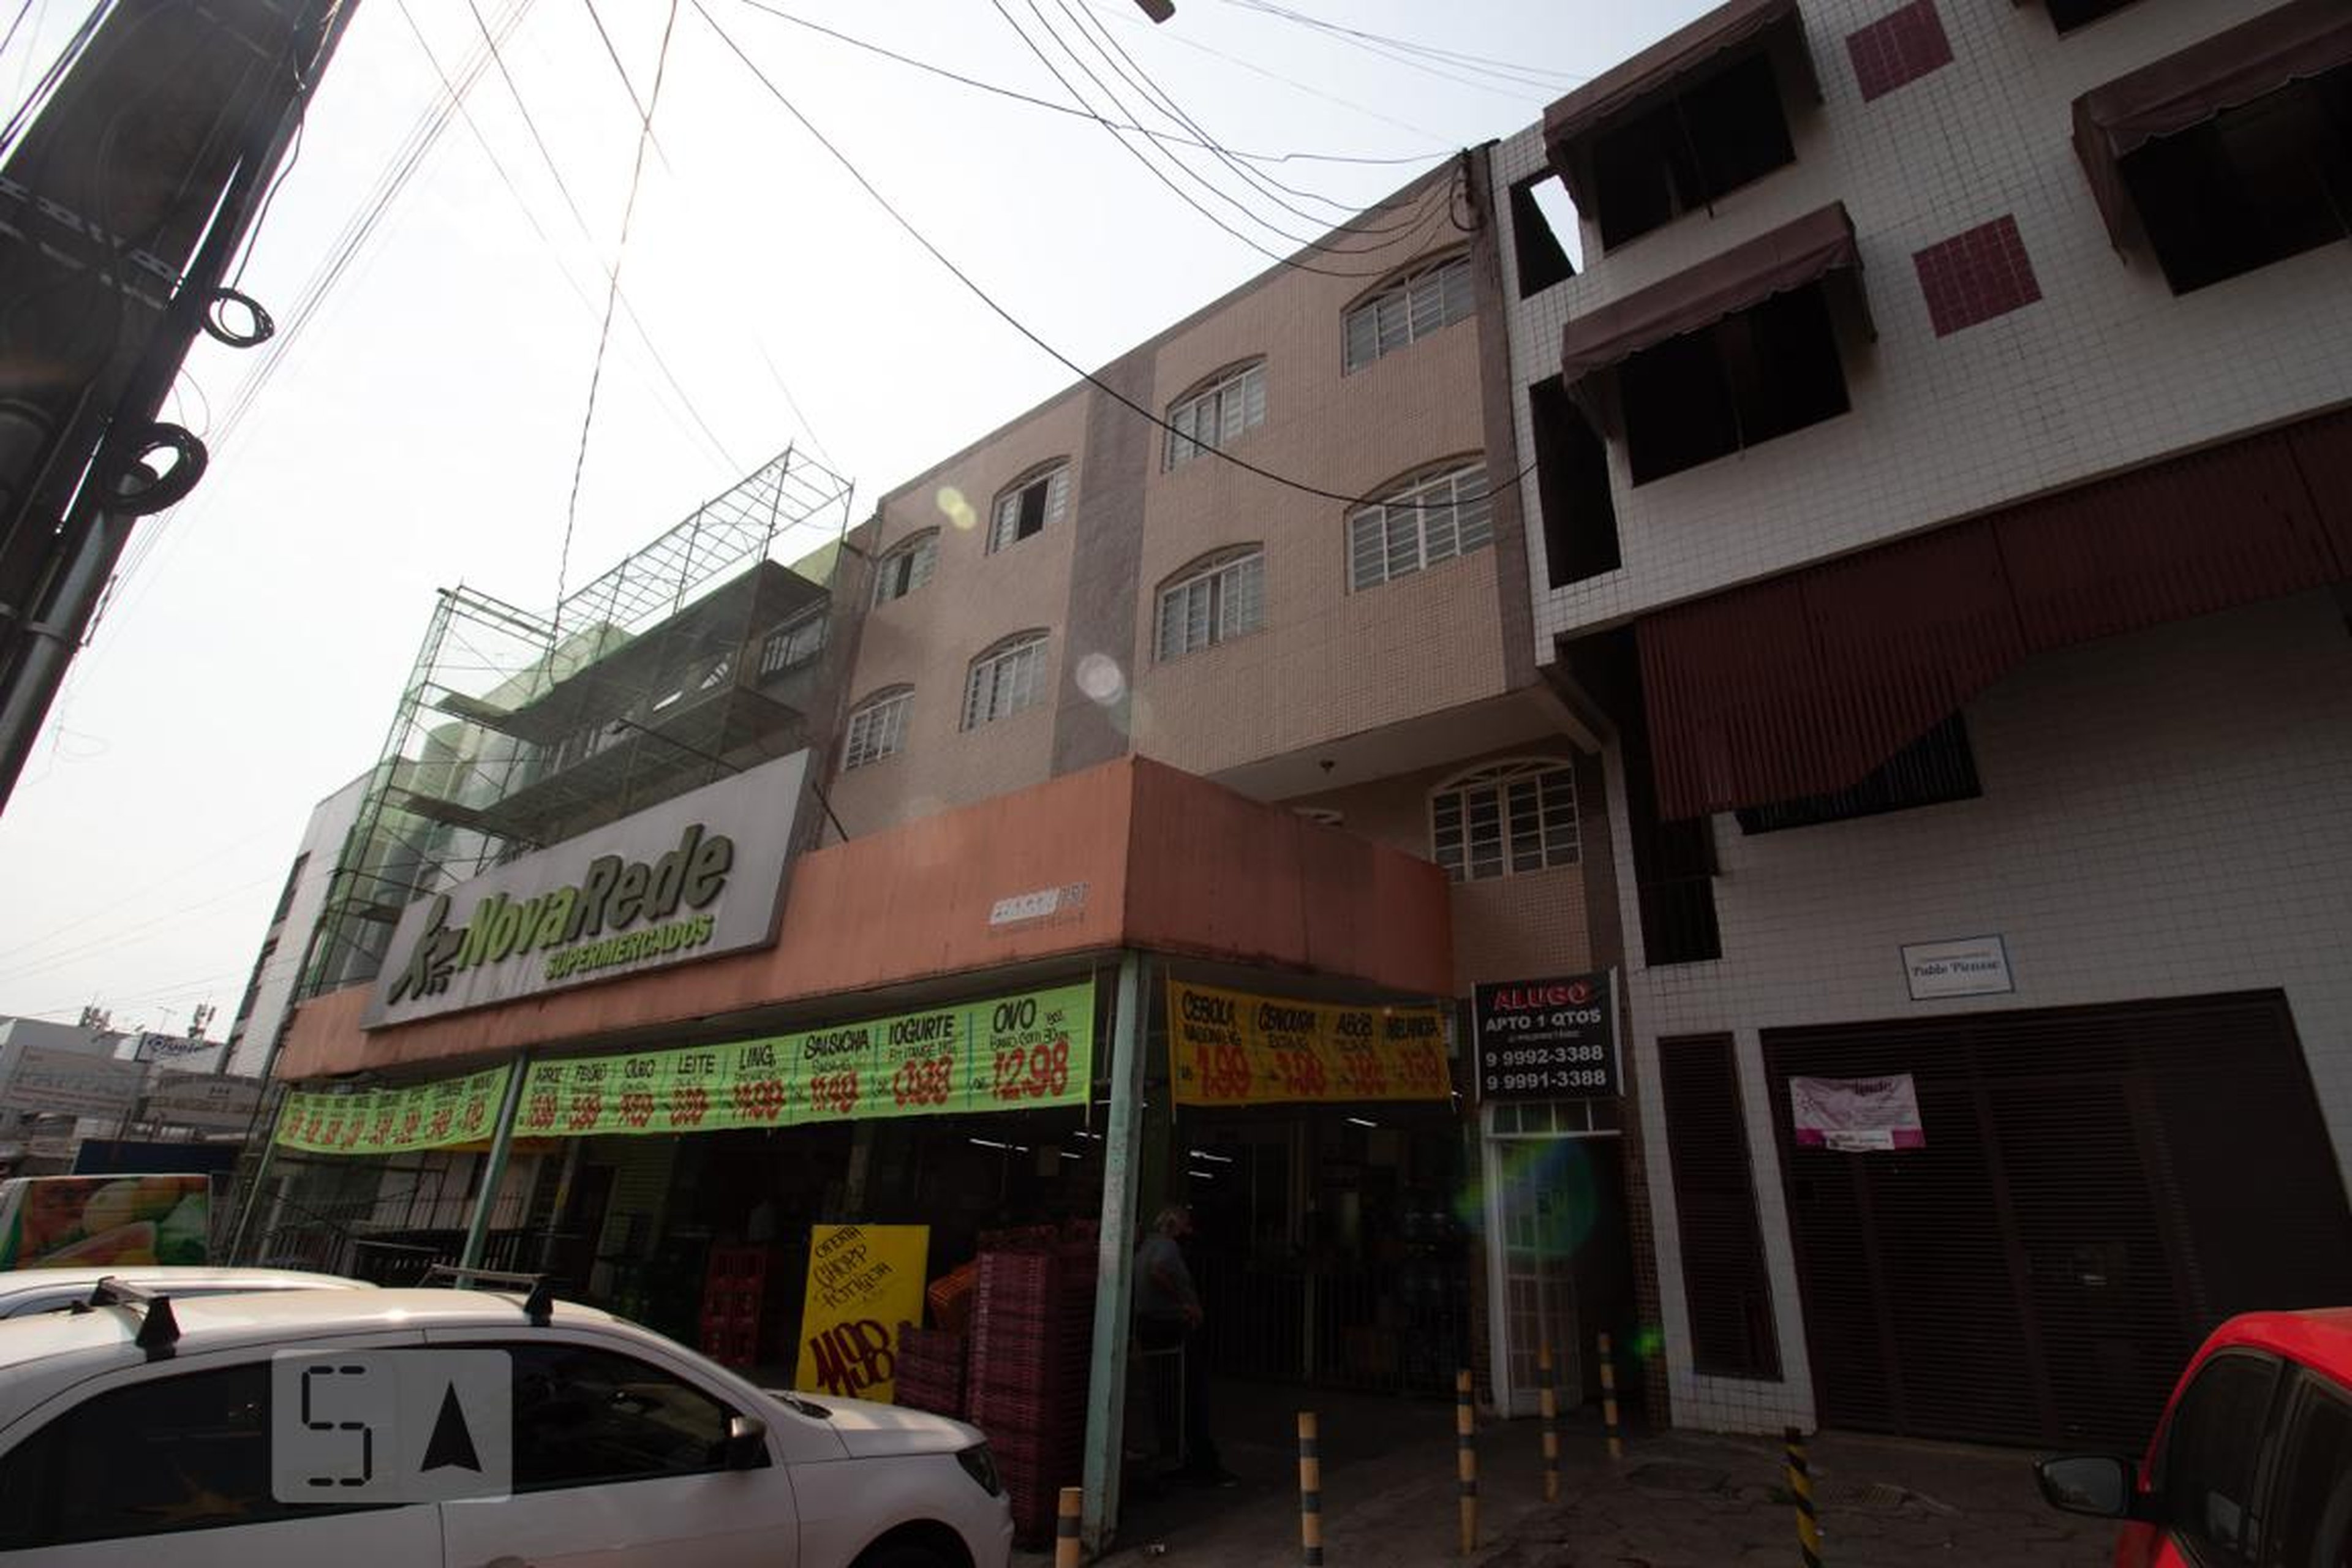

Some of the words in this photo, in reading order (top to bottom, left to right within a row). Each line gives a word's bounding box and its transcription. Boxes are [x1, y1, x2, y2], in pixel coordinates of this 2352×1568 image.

[545, 914, 715, 981] SUPERMERCADOS
[1494, 981, 1588, 1011] ALUGO
[889, 1014, 955, 1047] IOGURTE
[993, 998, 1037, 1034] OVO
[1485, 1016, 1532, 1032] APTO
[1536, 1014, 1545, 1028] 1
[1551, 1008, 1601, 1027] QTOS
[804, 1030, 870, 1060] SALSICHA
[1485, 1052, 1498, 1068] 9
[1502, 1045, 1604, 1067] 9992-3388
[677, 1054, 715, 1074] LEITE
[1487, 1075, 1498, 1091] 9
[1504, 1069, 1607, 1090] 9991-3388
